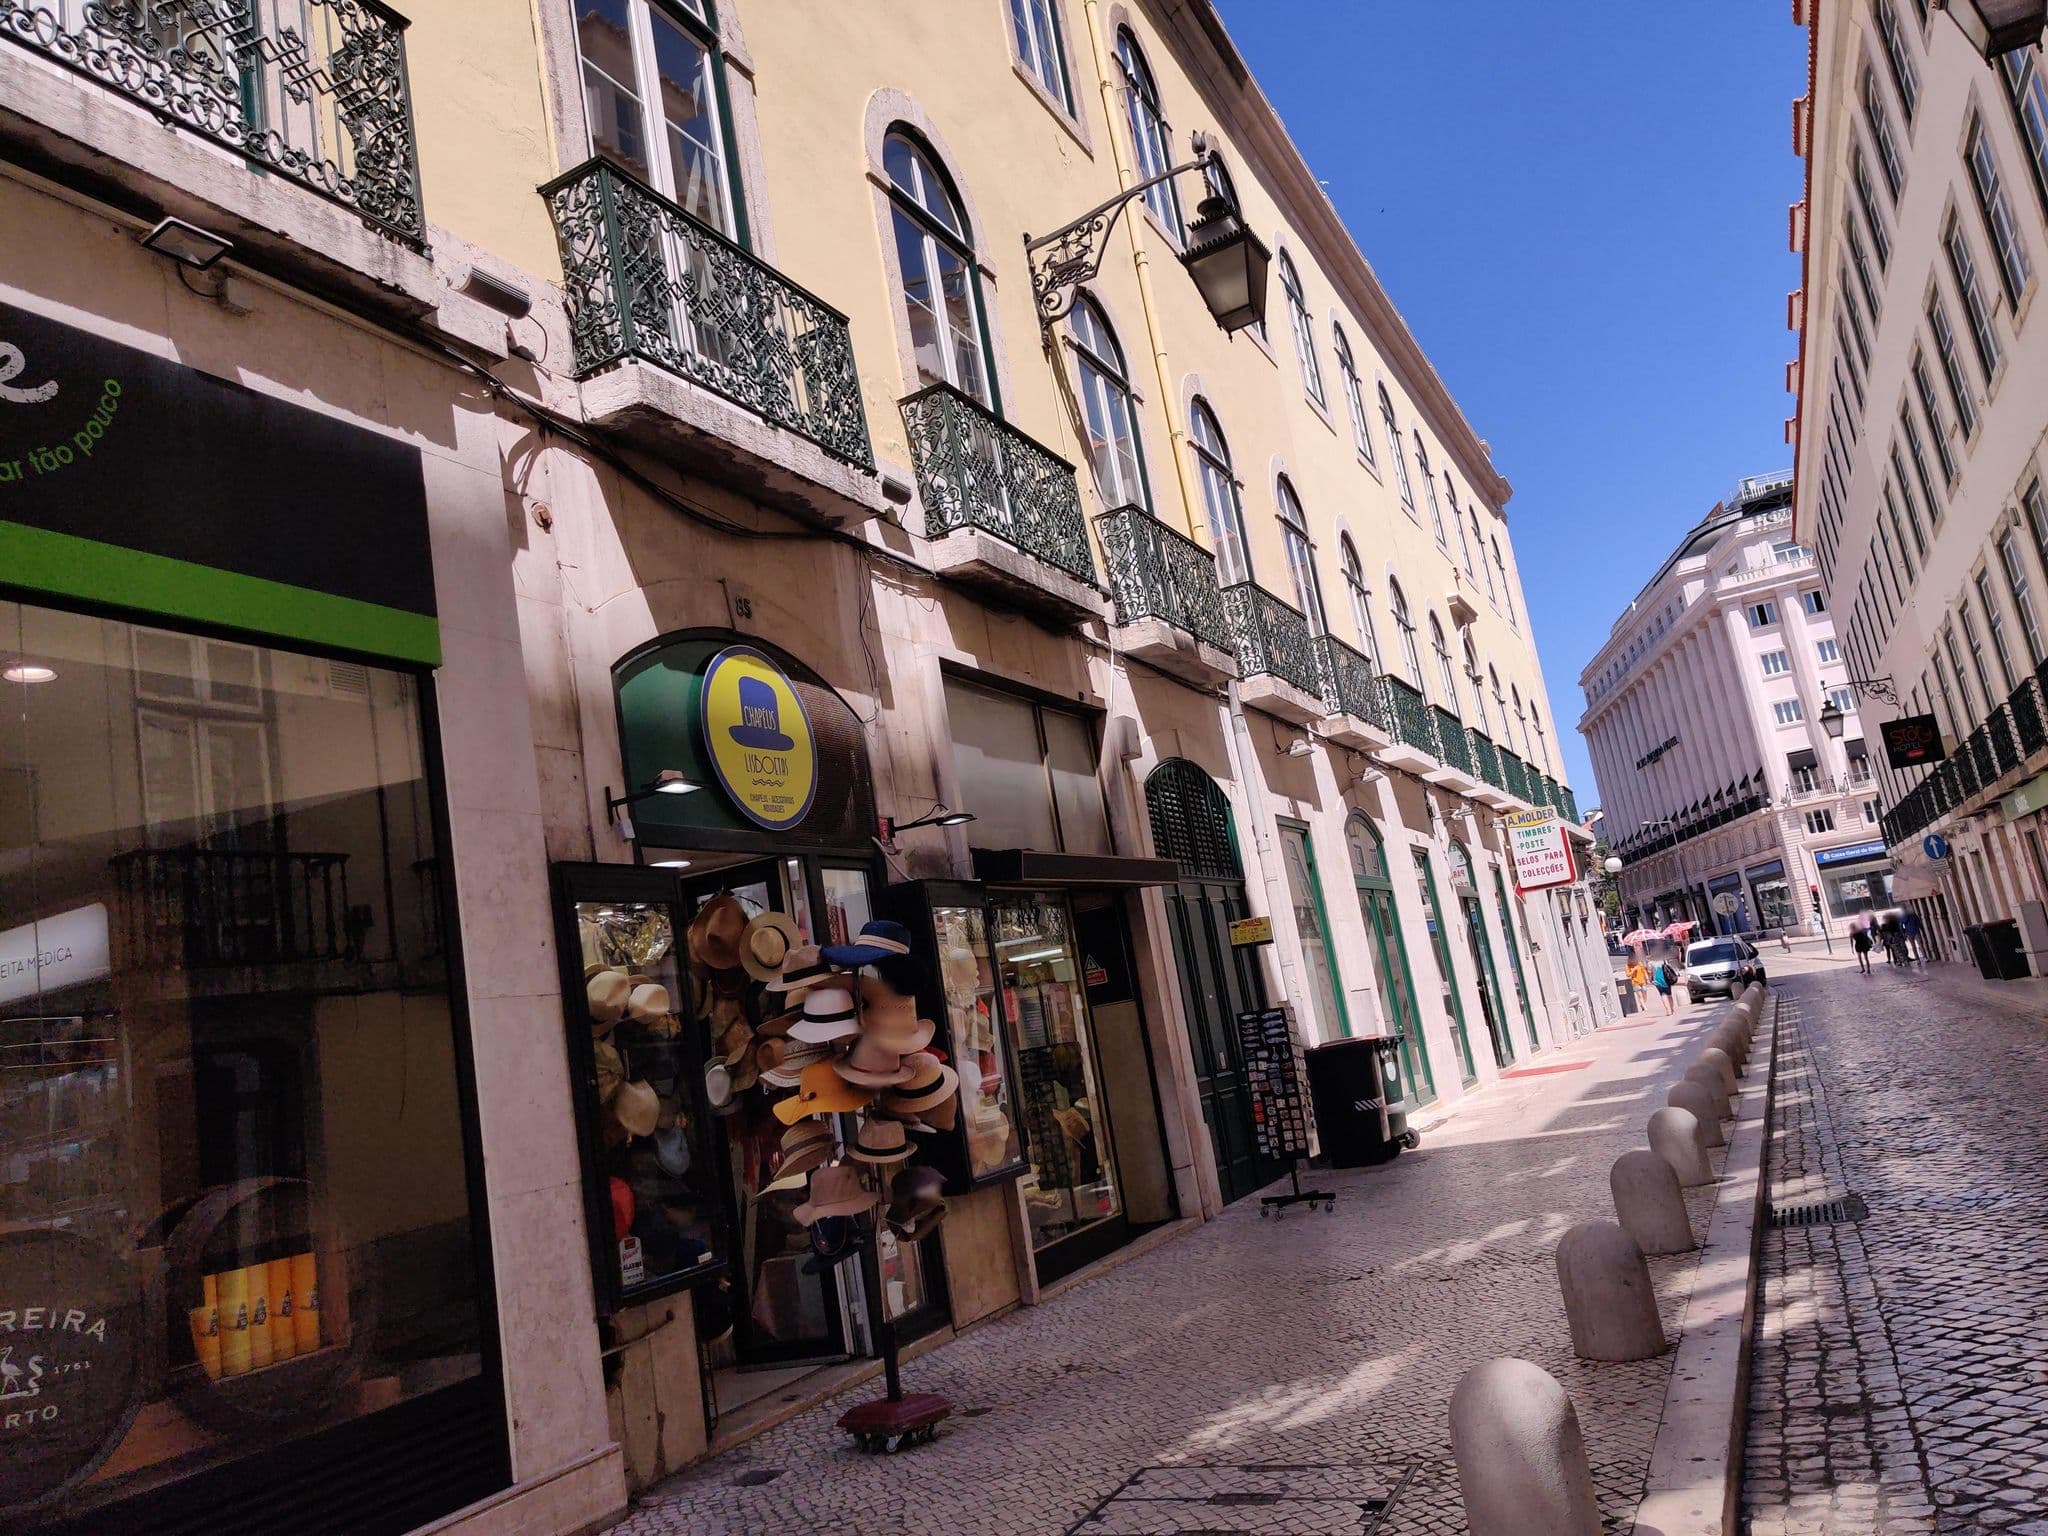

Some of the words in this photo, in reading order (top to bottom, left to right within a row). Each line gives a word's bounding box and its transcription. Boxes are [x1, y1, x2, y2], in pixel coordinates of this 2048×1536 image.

[28, 446, 74, 475] tão
[73, 379, 122, 457] pouco
[1517, 854, 1540, 867] SELOS
[1544, 849, 1565, 861] PARA
[54, 1360, 92, 1375] 1761
[5, 1404, 59, 1430] RTO
